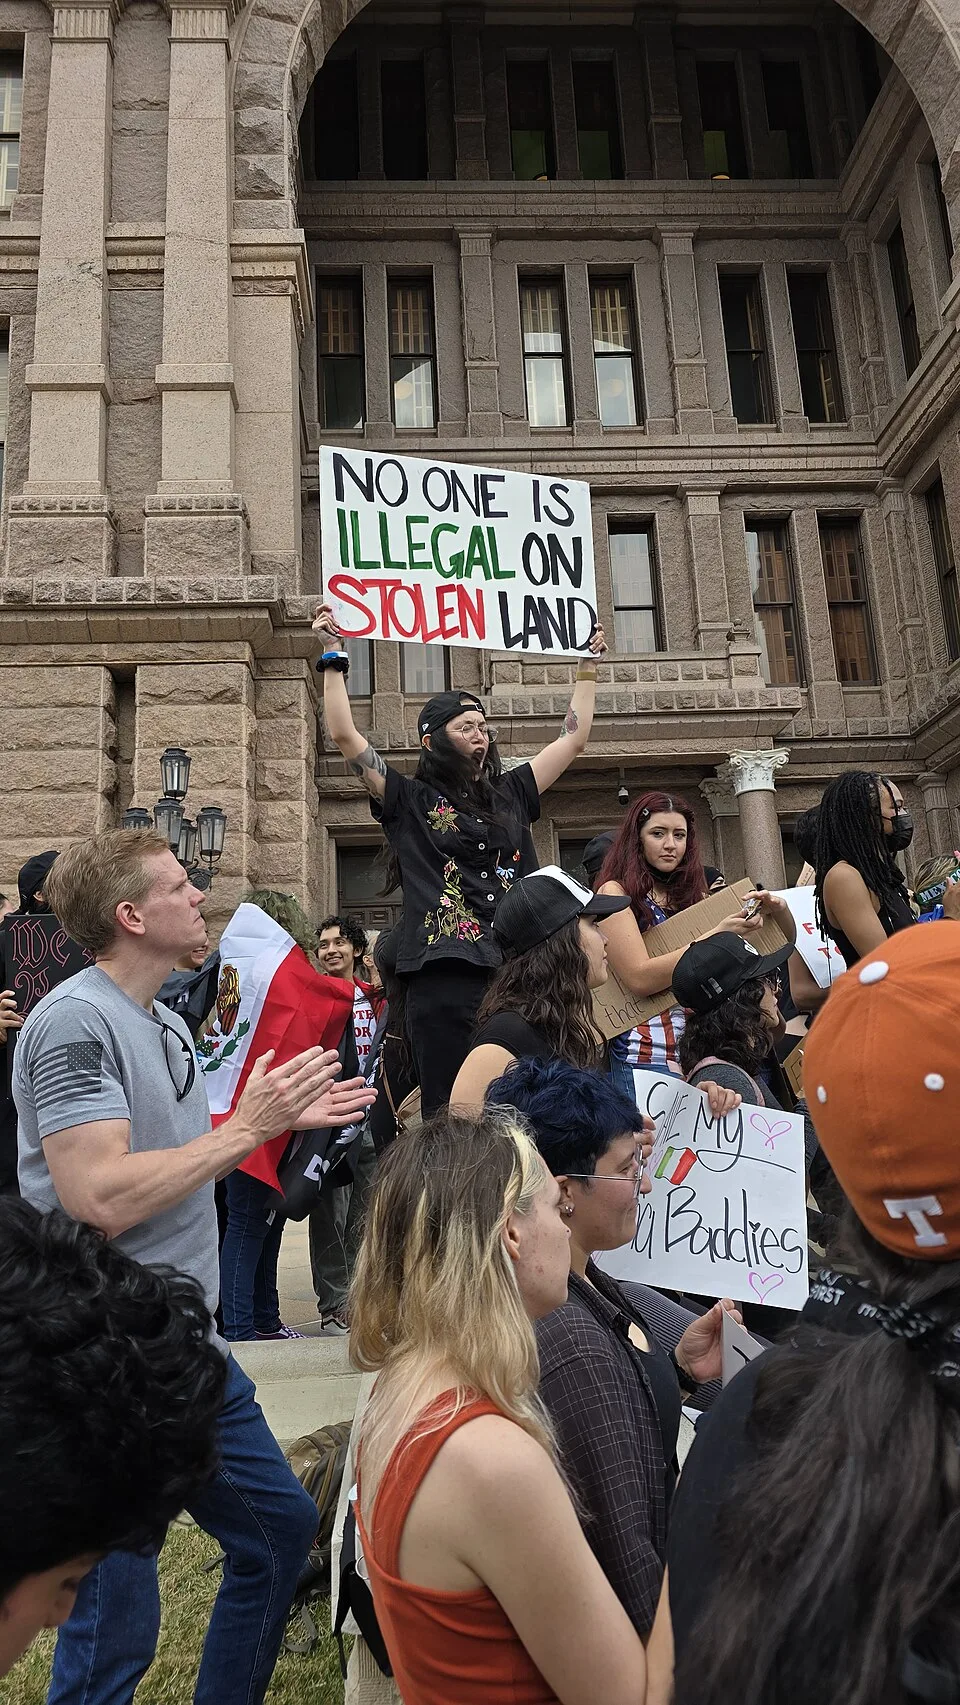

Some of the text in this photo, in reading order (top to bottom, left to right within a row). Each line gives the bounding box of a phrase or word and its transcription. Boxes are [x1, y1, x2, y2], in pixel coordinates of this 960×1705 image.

[333, 452, 575, 527] NO ONE IS
[336, 508, 583, 589] ILLEGAL ON
[327, 573, 598, 652] STOLEN LAND
[9, 919, 71, 969] We
[353, 1026, 373, 1038] OR
[605, 996, 646, 1029] that
[665, 1186, 804, 1274] Baddies
